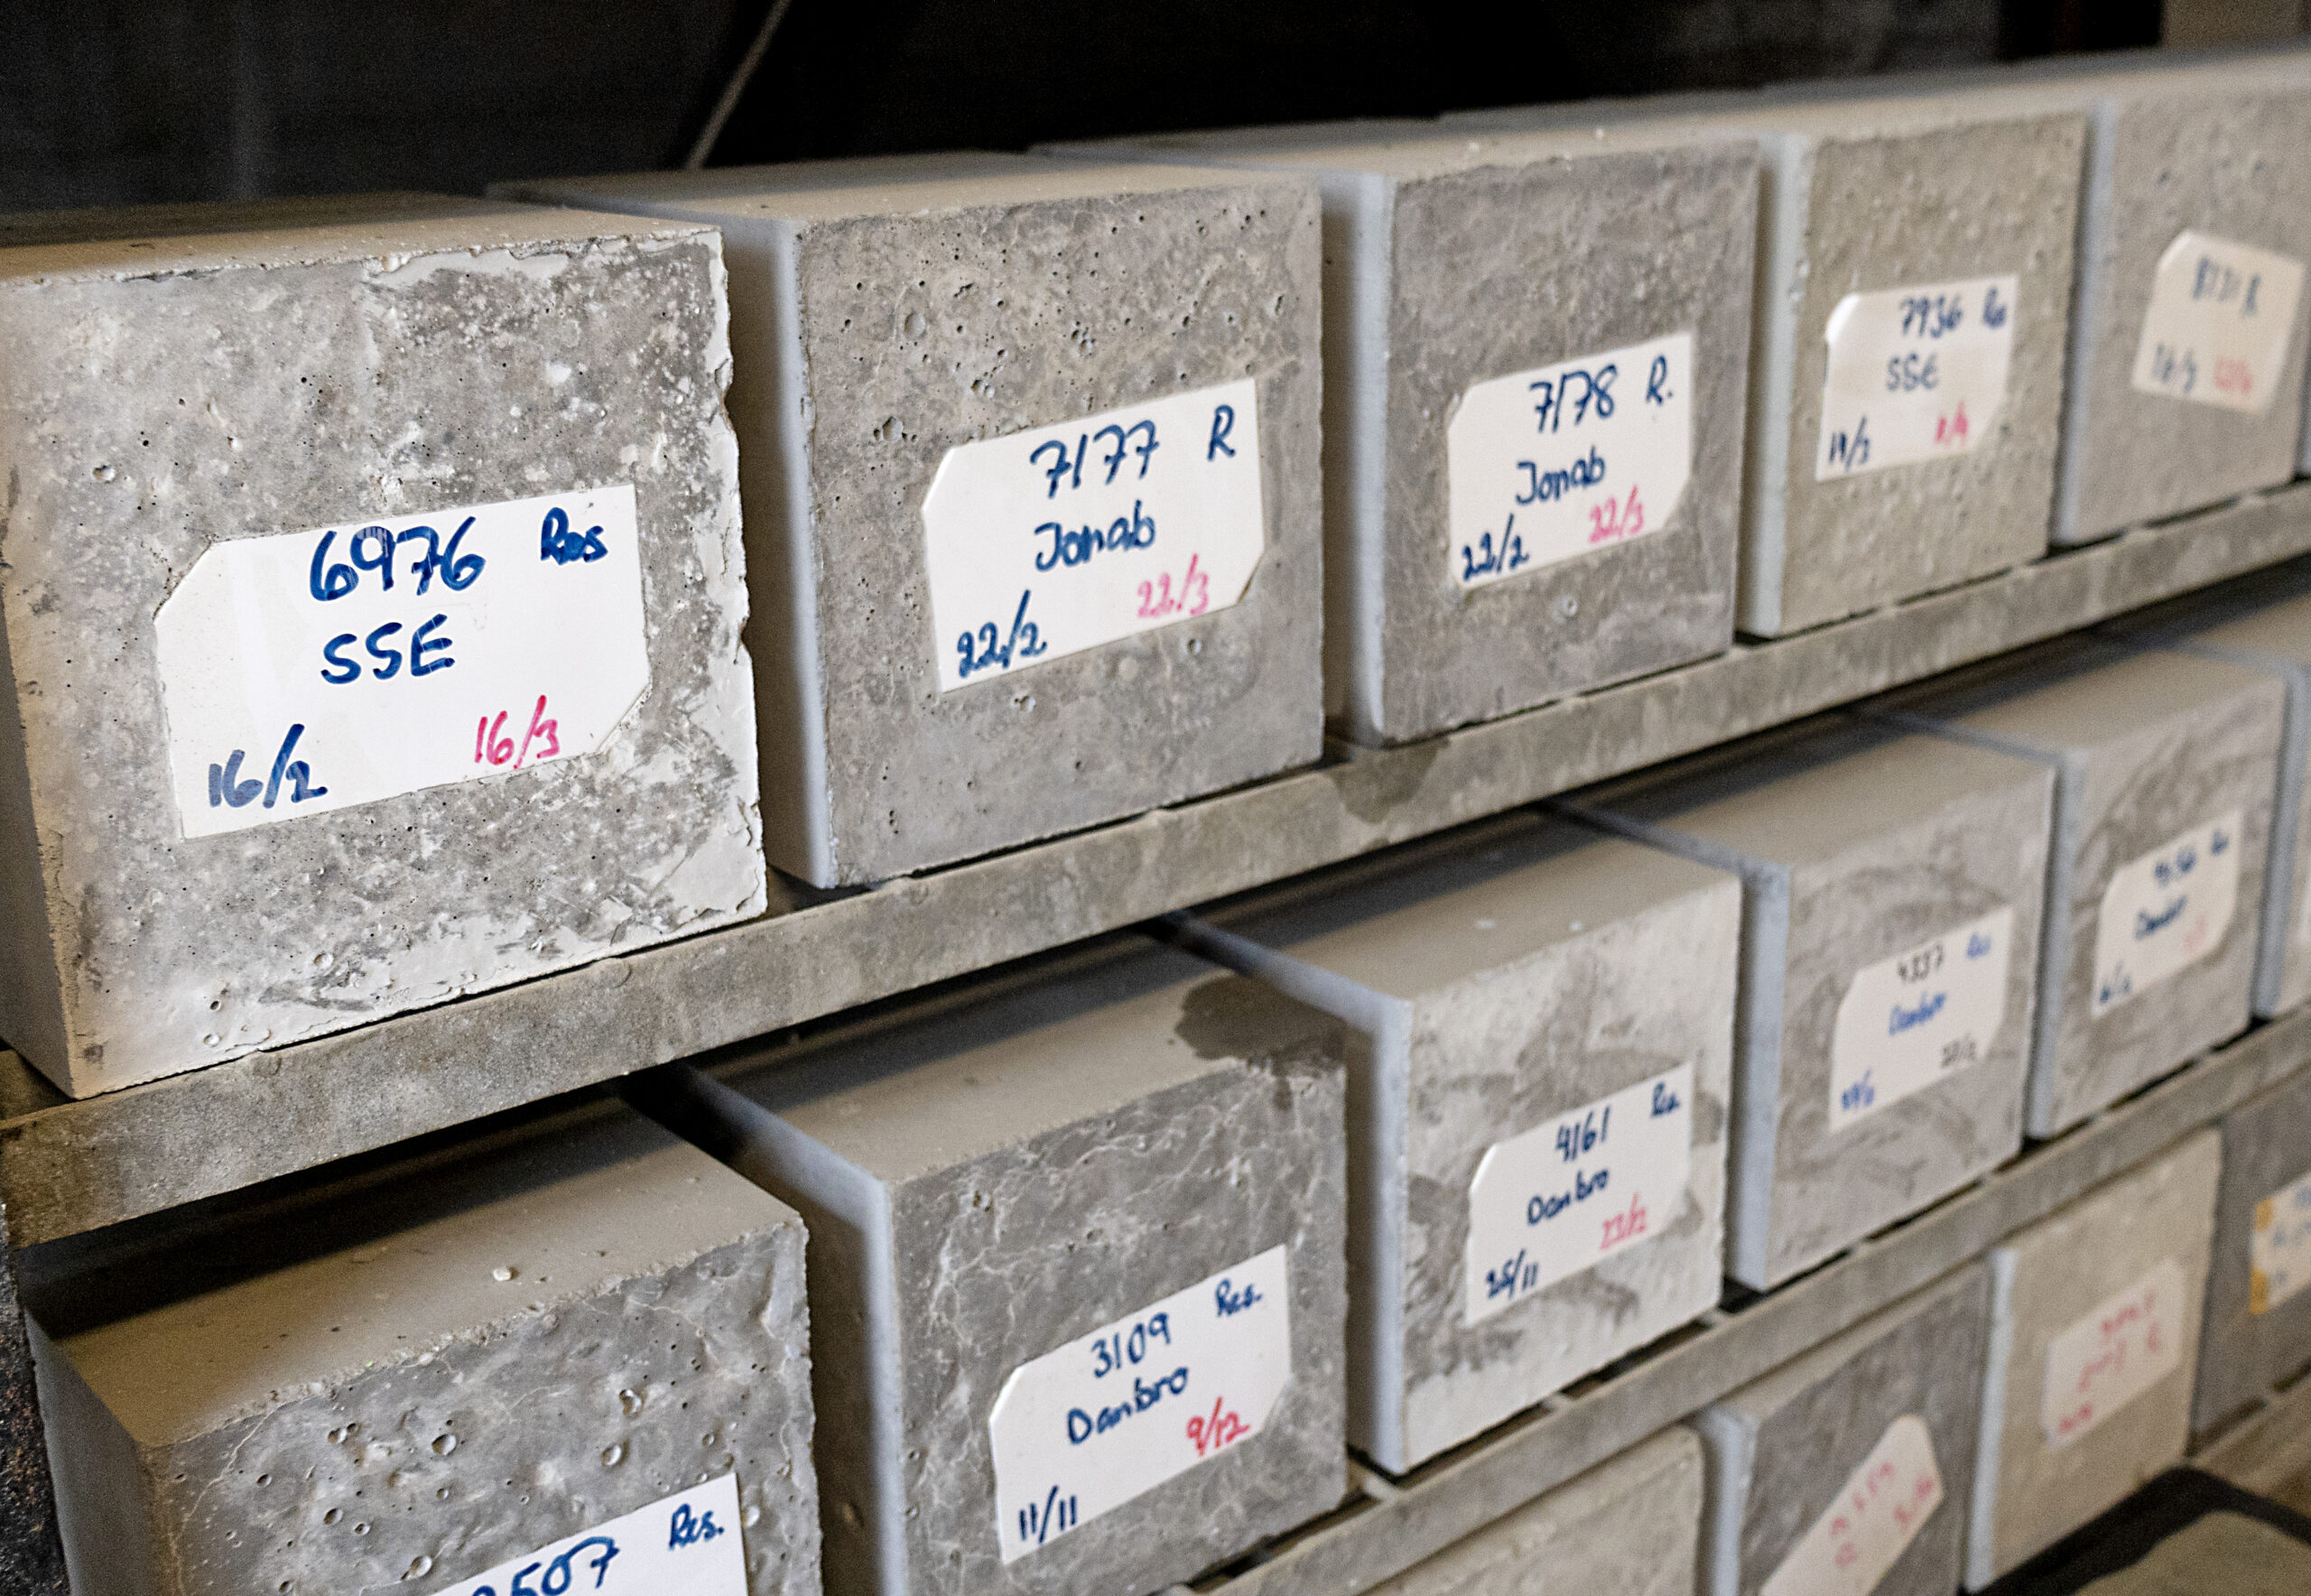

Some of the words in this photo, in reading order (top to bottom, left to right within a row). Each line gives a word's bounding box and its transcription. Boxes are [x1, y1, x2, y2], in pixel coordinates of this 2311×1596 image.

[1528, 362, 1619, 434] 7178
[1029, 419, 1161, 500] 7177
[1206, 404, 1237, 462] R
[310, 515, 487, 602] 6976
[1033, 498, 1157, 573] Jonab
[1135, 552, 1210, 619] 22/3
[320, 612, 456, 685] SSE
[955, 588, 1048, 679] 22/2
[208, 722, 329, 809] 16/2
[473, 693, 561, 770] 16/3
[1091, 1311, 1172, 1378] 3109
[1185, 1396, 1251, 1457] 9/12
[1018, 1484, 1079, 1545] 11/11
[472, 1536, 621, 1596] 507
